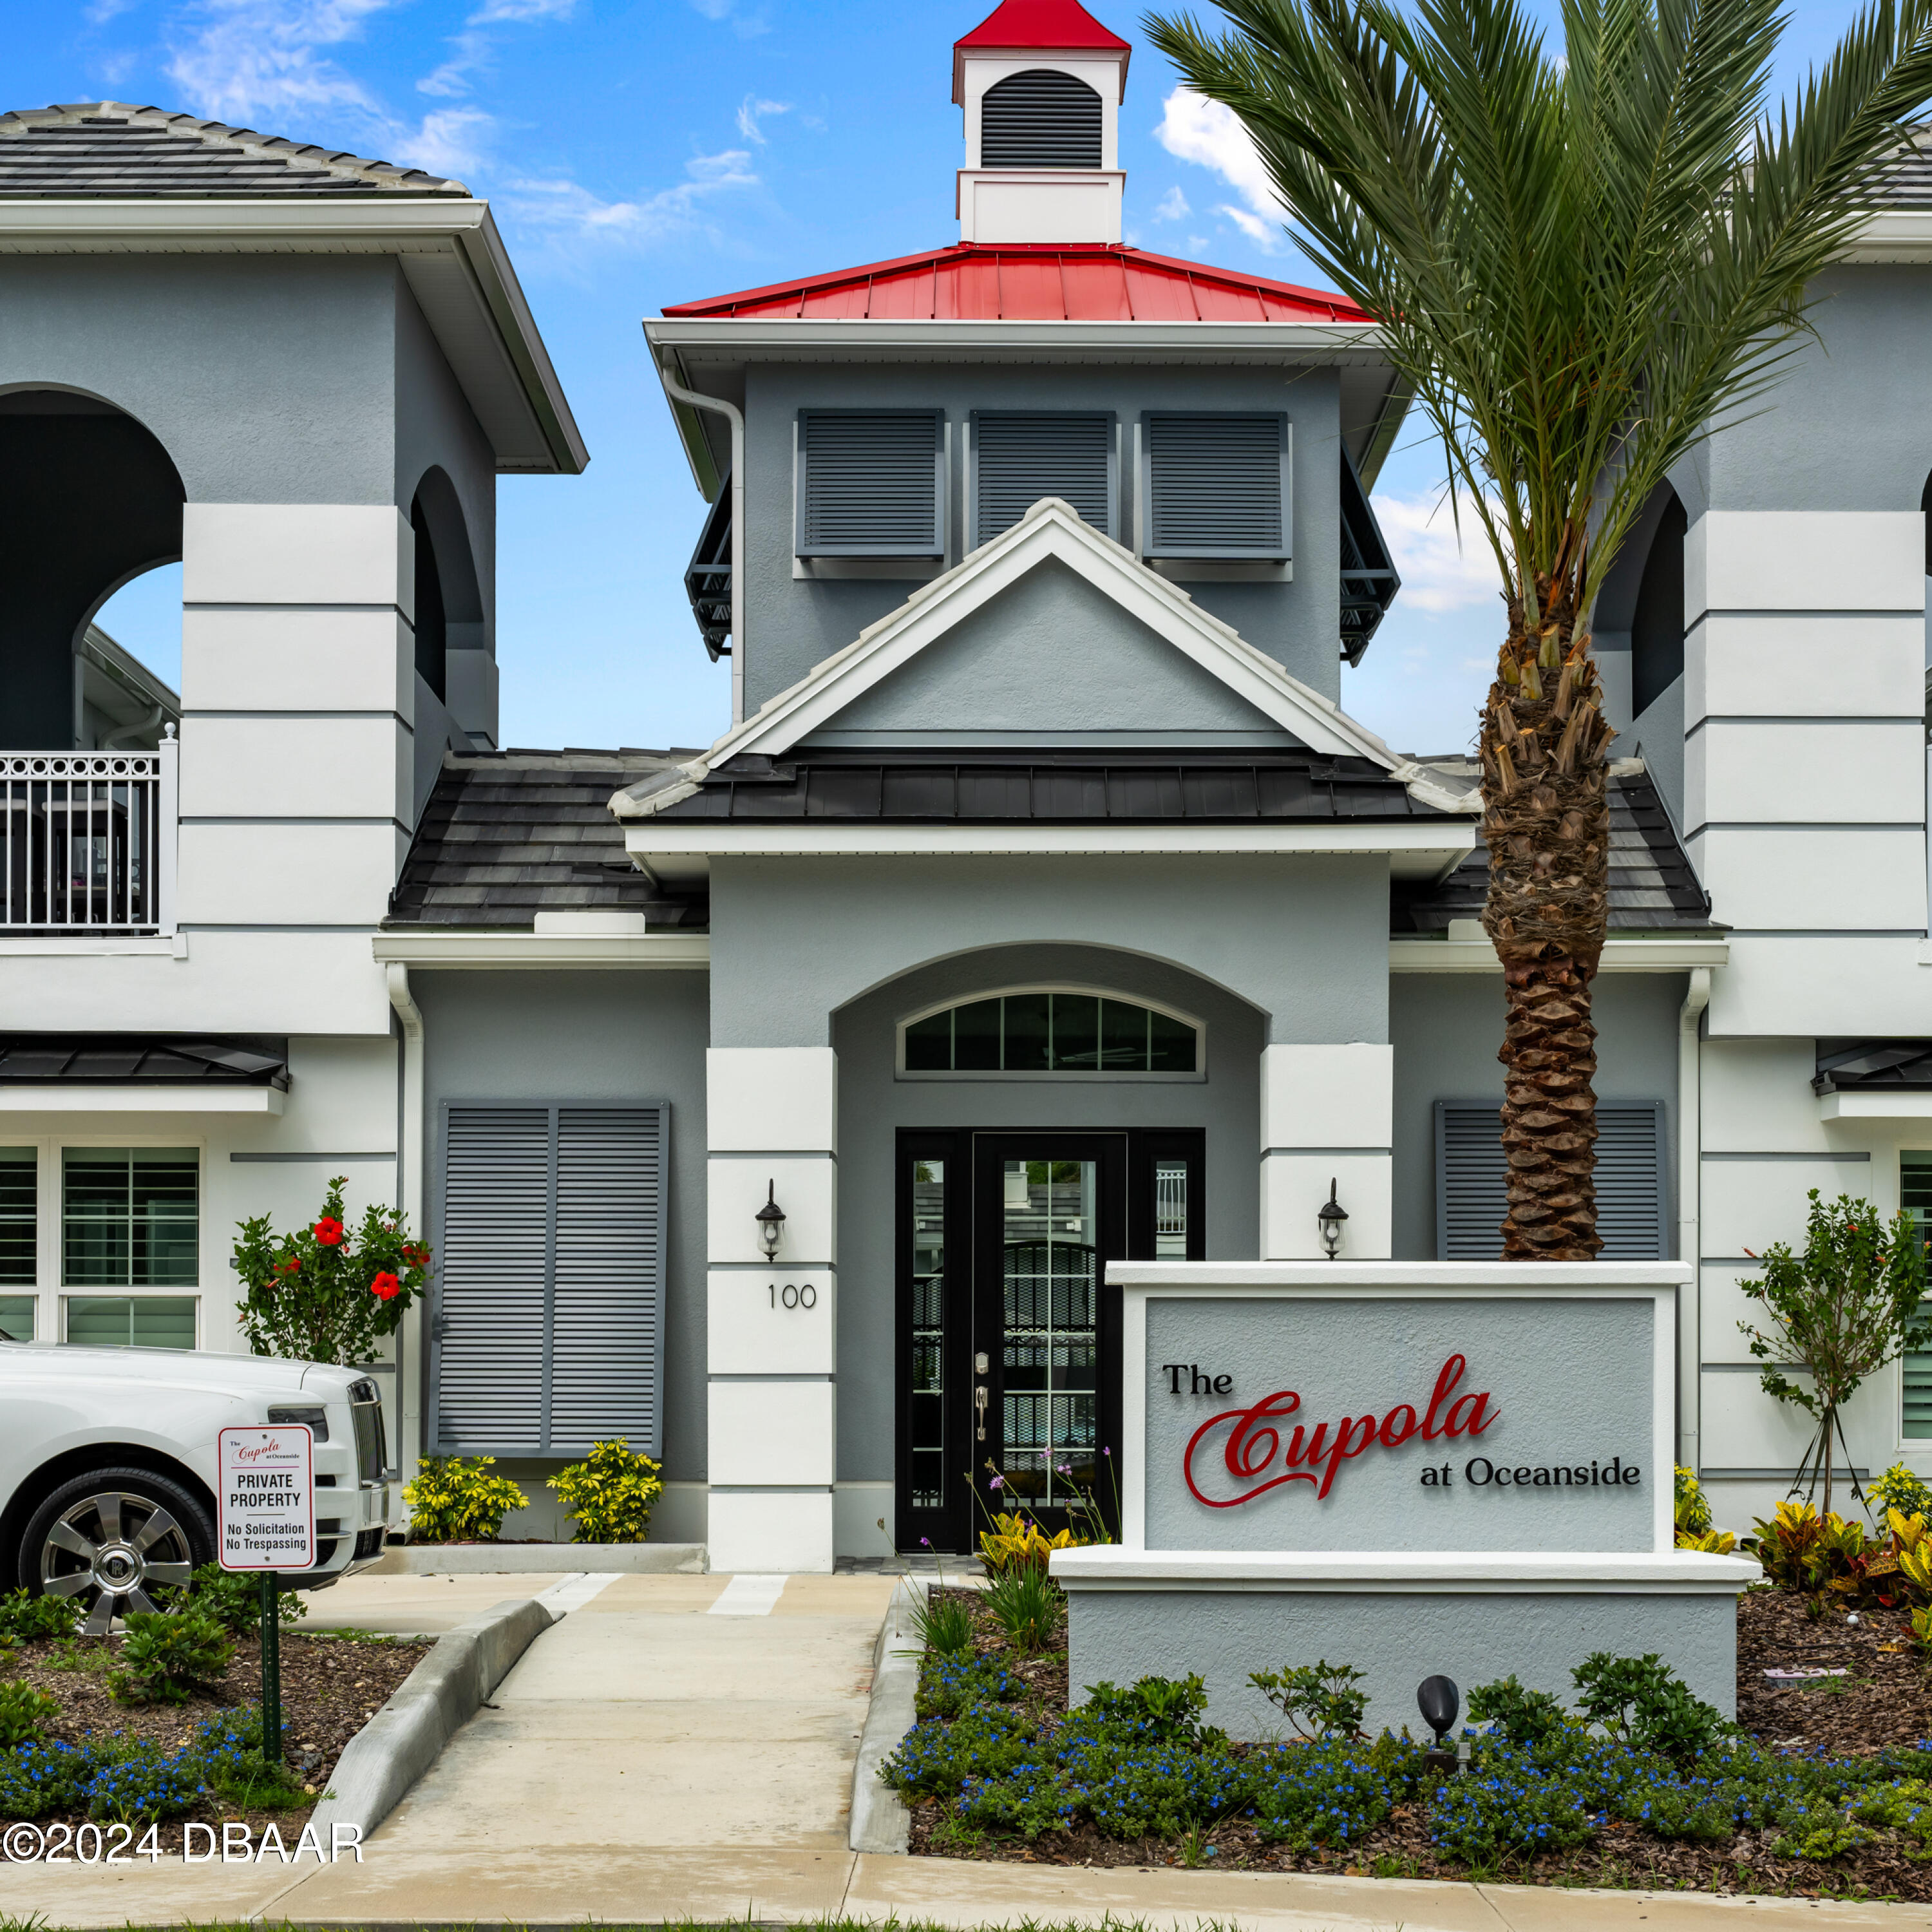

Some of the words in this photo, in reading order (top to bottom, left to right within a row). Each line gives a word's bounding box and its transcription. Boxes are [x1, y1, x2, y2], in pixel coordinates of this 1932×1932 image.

[768, 1284, 816, 1309] 100
[1162, 1364, 1233, 1396] The
[1184, 1354, 1501, 1508] Cupola
[232, 1439, 281, 1464] Cupola
[238, 1473, 293, 1488] PRIVATE
[1421, 1462, 1452, 1486] at
[1465, 1457, 1640, 1486] Oceanside
[231, 1493, 301, 1508] PROPERTY
[228, 1524, 242, 1535] No
[245, 1523, 305, 1535] Solicitation
[227, 1538, 240, 1550] No
[243, 1537, 307, 1551] Trespassing
